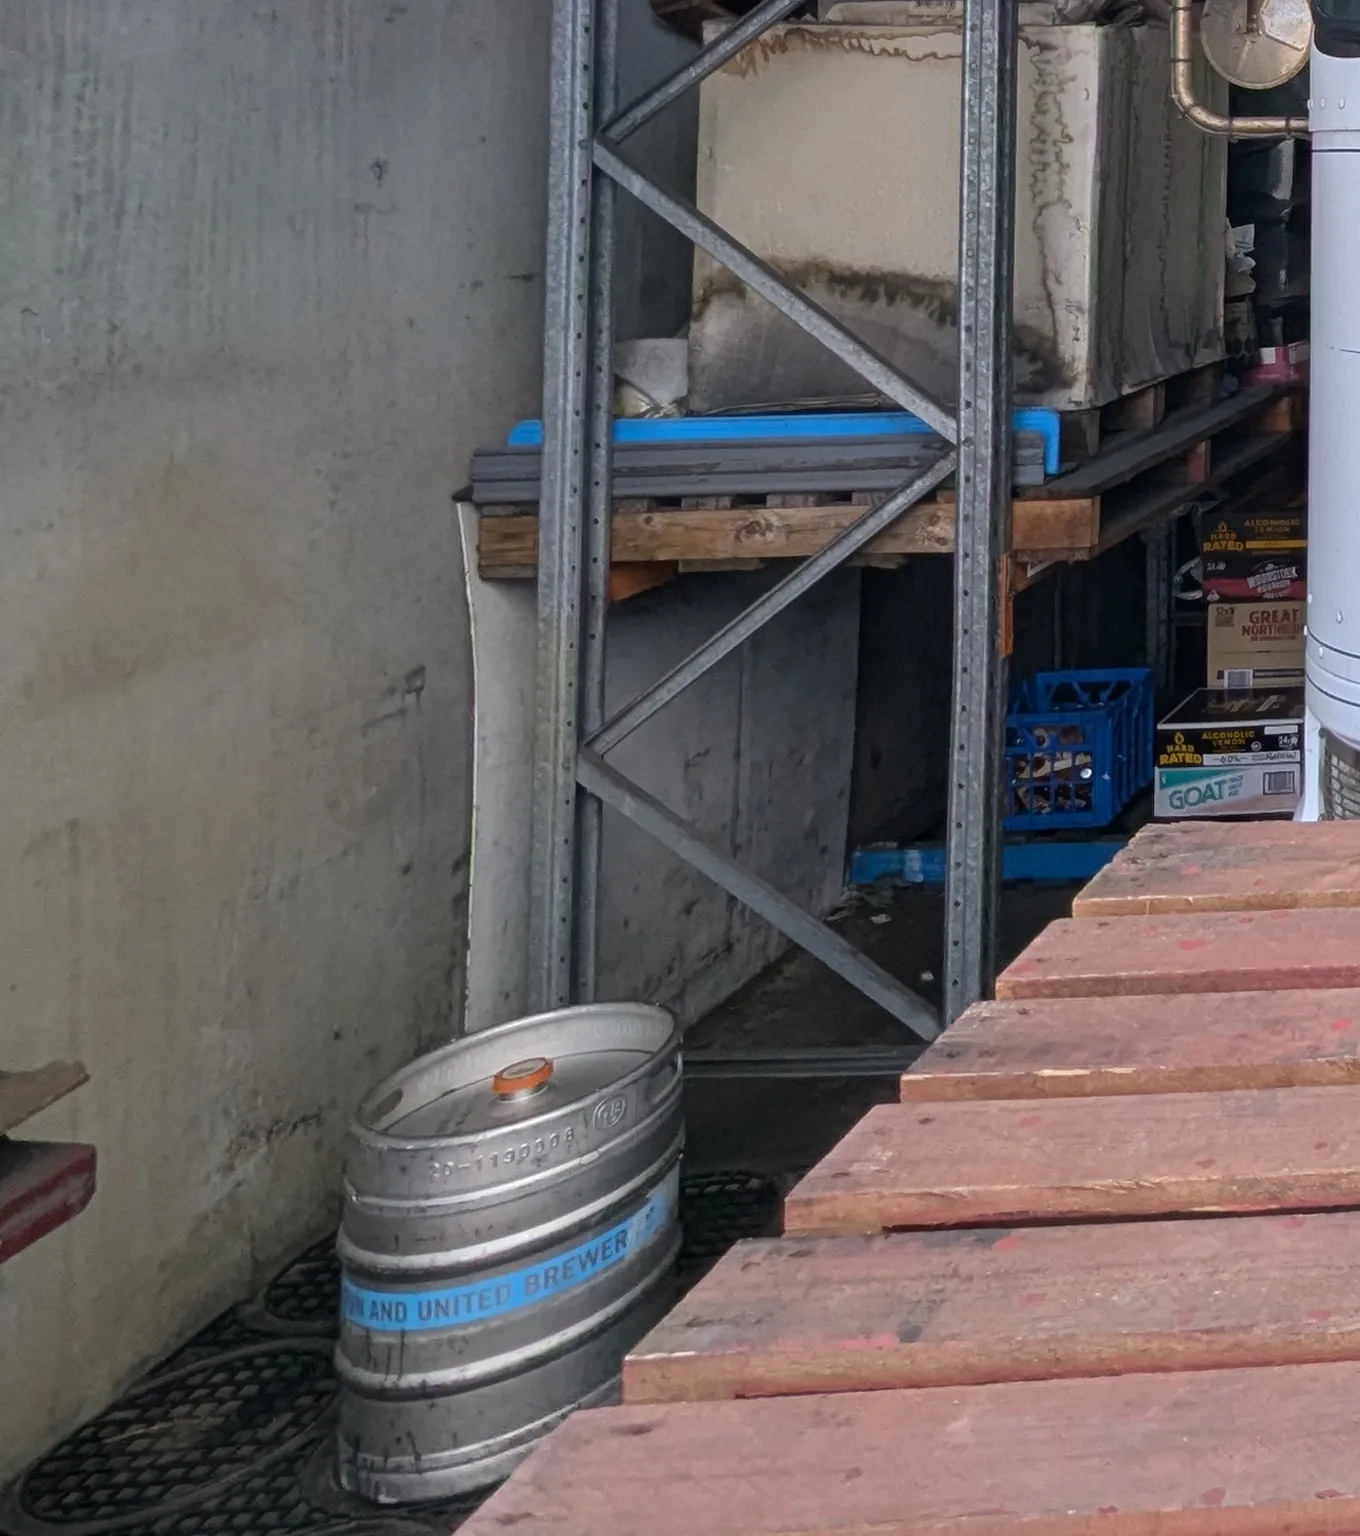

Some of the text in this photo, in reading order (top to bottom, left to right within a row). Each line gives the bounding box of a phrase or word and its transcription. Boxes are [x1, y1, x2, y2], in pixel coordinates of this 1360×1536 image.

[1203, 540, 1244, 552] RATED
[1249, 608, 1300, 624] GREAT
[1201, 730, 1255, 740] ALCOHOLIC
[1159, 752, 1203, 765] RATED
[1168, 780, 1227, 810] GOAT
[368, 1300, 408, 1322] AND
[416, 1284, 512, 1322] UNITED
[525, 1227, 629, 1296] BREWER
